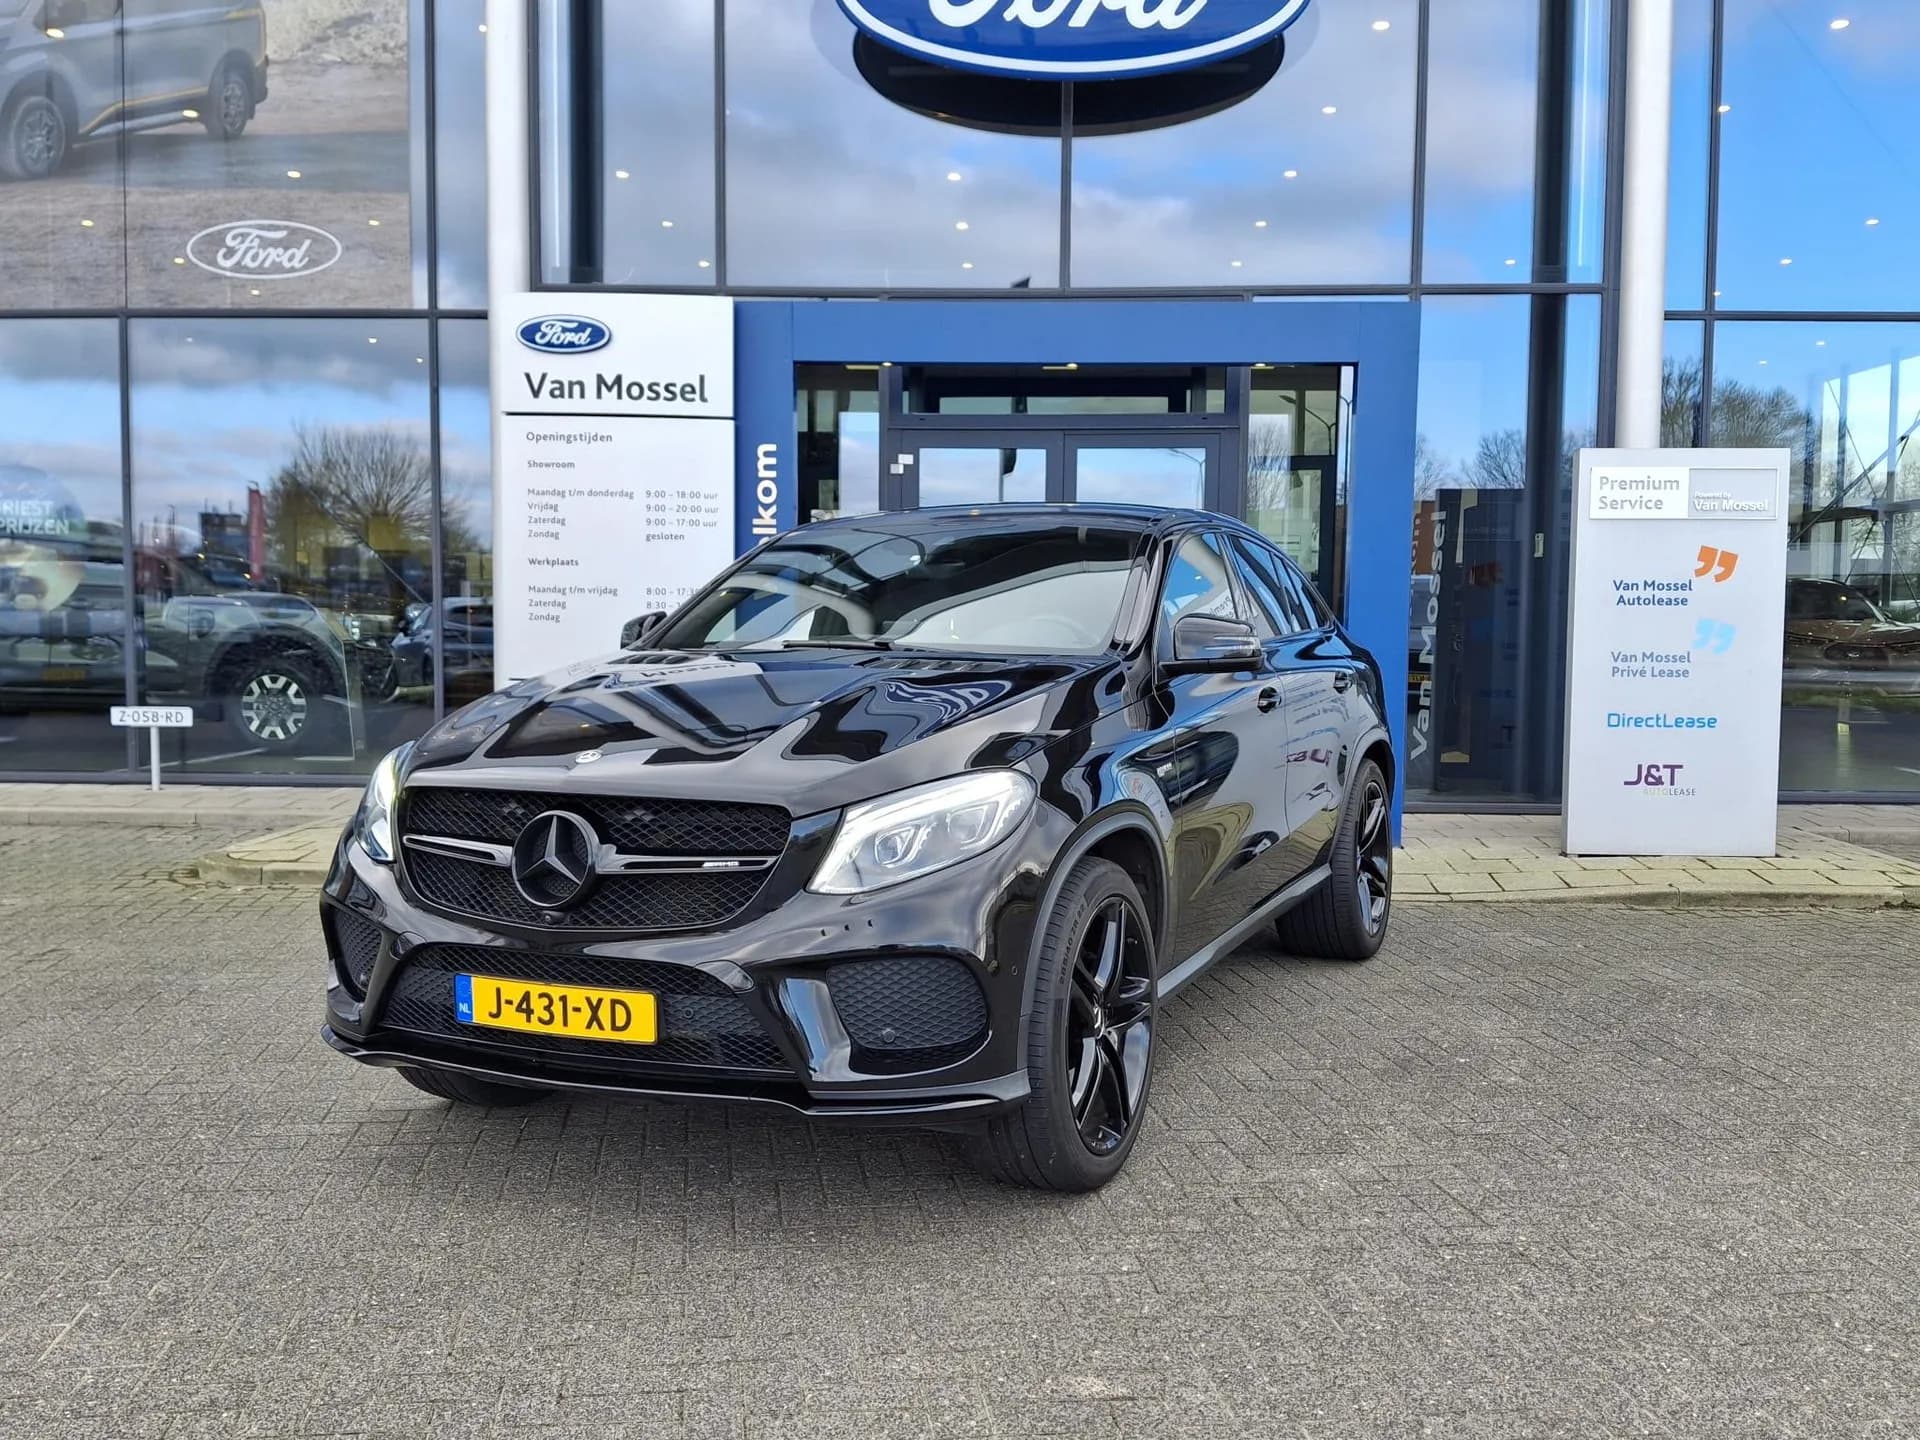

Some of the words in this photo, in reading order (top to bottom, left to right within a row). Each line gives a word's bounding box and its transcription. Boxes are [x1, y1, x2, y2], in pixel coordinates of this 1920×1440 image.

[217, 227, 313, 269] Ford
[535, 319, 592, 346] Ford
[524, 371, 586, 400] Van
[595, 372, 709, 404] Mossel
[526, 431, 613, 445] Openingstijden
[527, 459, 576, 469] Showroom
[1599, 475, 1680, 491] Premium
[527, 487, 567, 499] Maandag
[568, 488, 585, 498] t/m
[586, 488, 635, 500] donderdag
[527, 501, 559, 513] Vrijdag
[1598, 495, 1664, 511] Service
[1693, 499, 1718, 512] Van
[1722, 499, 1769, 512] Mossel
[527, 516, 566, 527] Zaterdag
[527, 529, 560, 541] Zondag
[645, 531, 685, 543] gesloten
[528, 557, 579, 568] Werkplaats
[528, 584, 567, 596] Maandag
[568, 585, 585, 595] t/m
[586, 585, 618, 597] vrijdag
[1418, 510, 1448, 664] Mossel
[1613, 579, 1640, 592] Van
[1643, 578, 1693, 592] Mossel
[528, 598, 567, 610] Zaterdag
[1616, 594, 1689, 607] Autolease
[528, 612, 561, 624] Zondag
[1610, 651, 1638, 664] Van
[1641, 651, 1692, 664] Mossel
[1611, 665, 1647, 678] Privé
[1651, 666, 1690, 678] Lease
[1410, 679, 1433, 761] Van
[1607, 713, 1718, 729] DirectLease
[1623, 763, 1684, 787] J&T
[458, 1002, 472, 1014] NL
[488, 987, 632, 1033] J-431-XD
